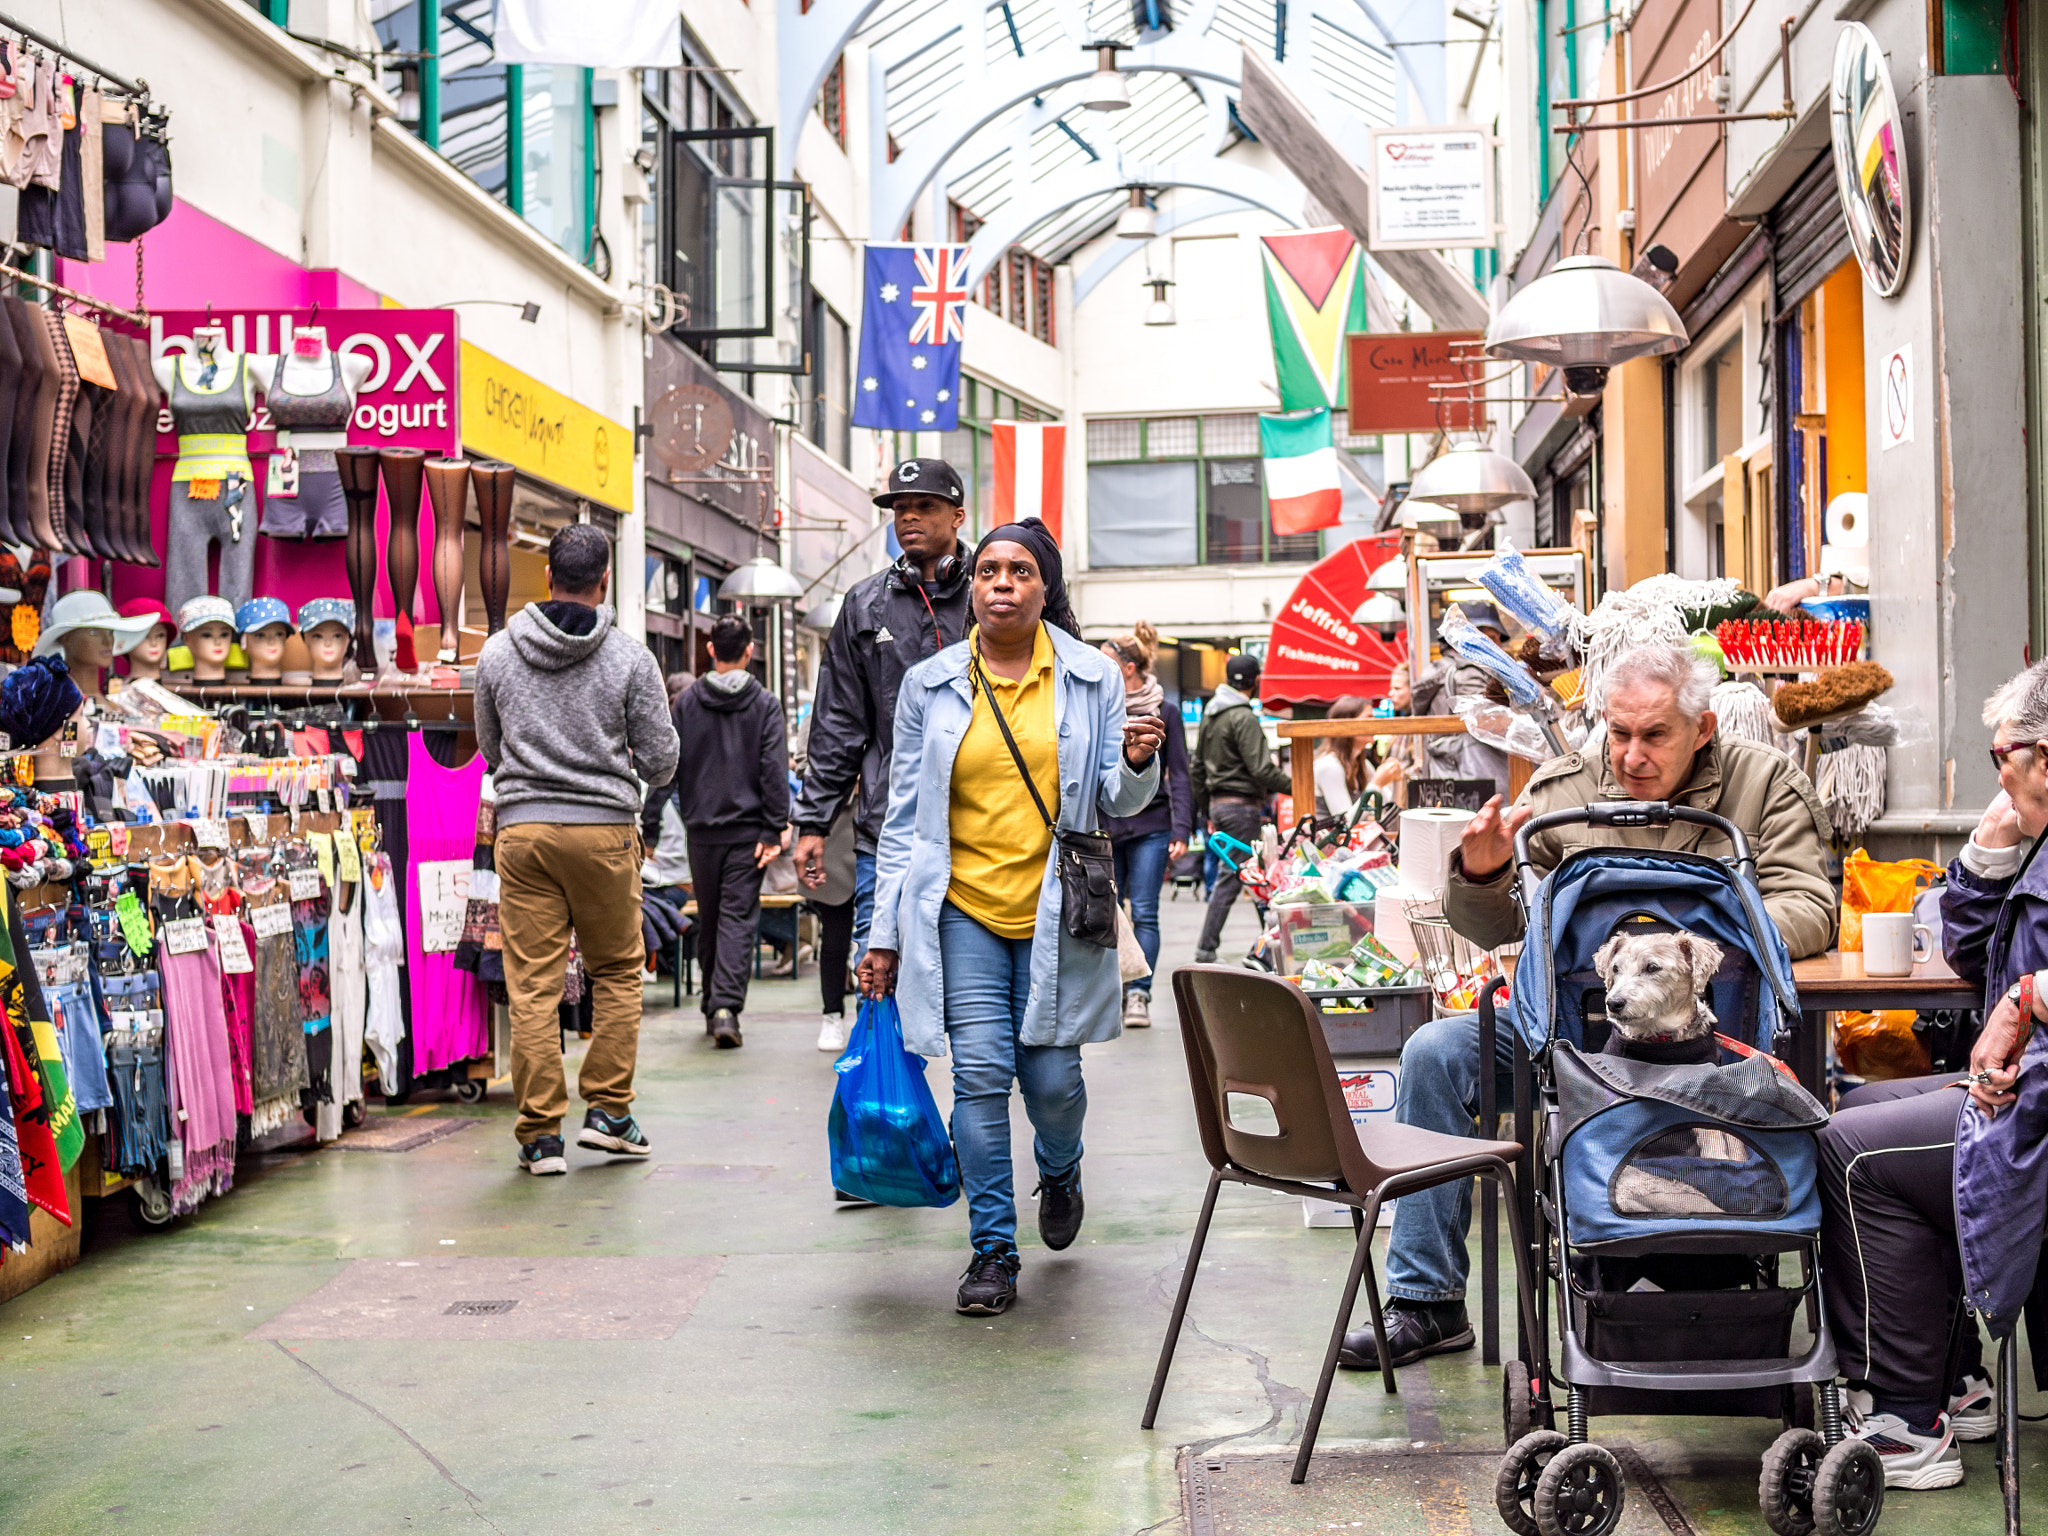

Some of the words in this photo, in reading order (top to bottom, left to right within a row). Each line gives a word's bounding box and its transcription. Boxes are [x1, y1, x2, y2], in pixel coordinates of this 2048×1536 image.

[355, 397, 448, 436] ogurt
[188, 438, 226, 452] SPORT
[1291, 598, 1360, 647] Jeffries
[1277, 645, 1360, 672] Fishmongers
[1347, 1099, 1374, 1107] ARKETS
